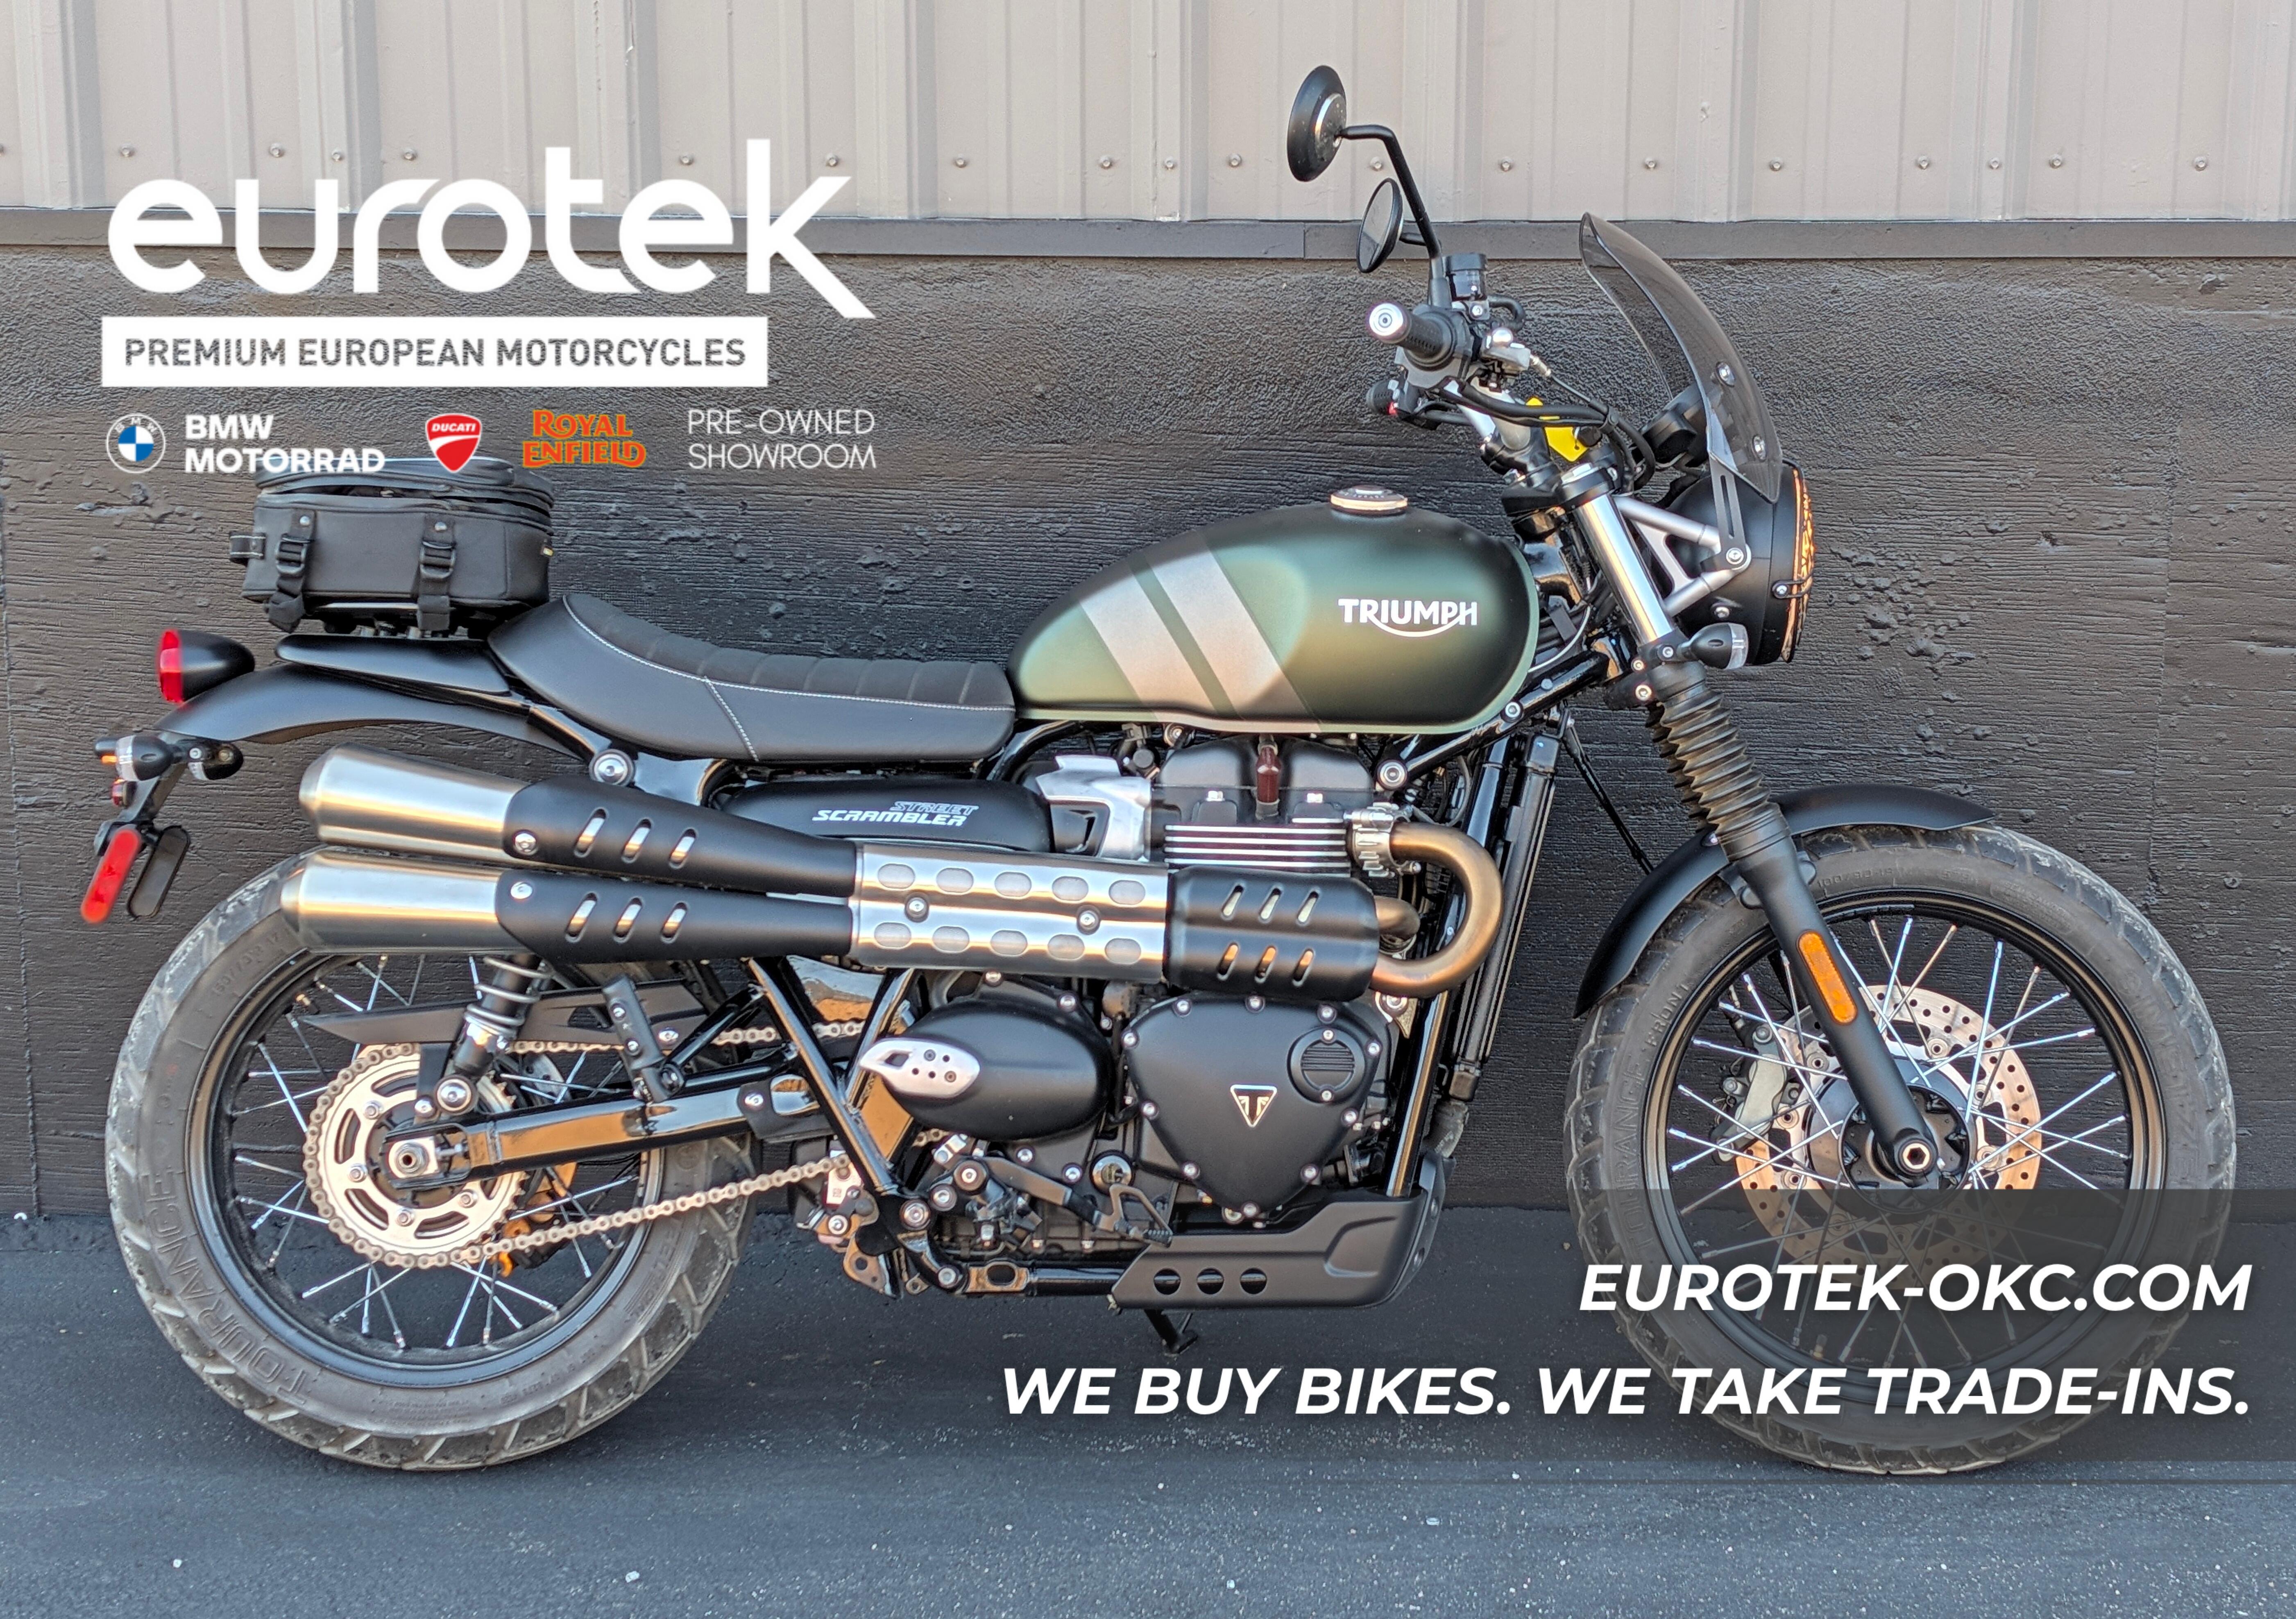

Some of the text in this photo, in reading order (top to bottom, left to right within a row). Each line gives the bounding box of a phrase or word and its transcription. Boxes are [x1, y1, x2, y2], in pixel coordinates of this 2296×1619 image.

[1338, 598, 1478, 637] TRIUMPH
[811, 810, 967, 827] SCRAMBLER
[889, 801, 979, 816] STREET
[141, 1171, 320, 1405] TOURANCE
